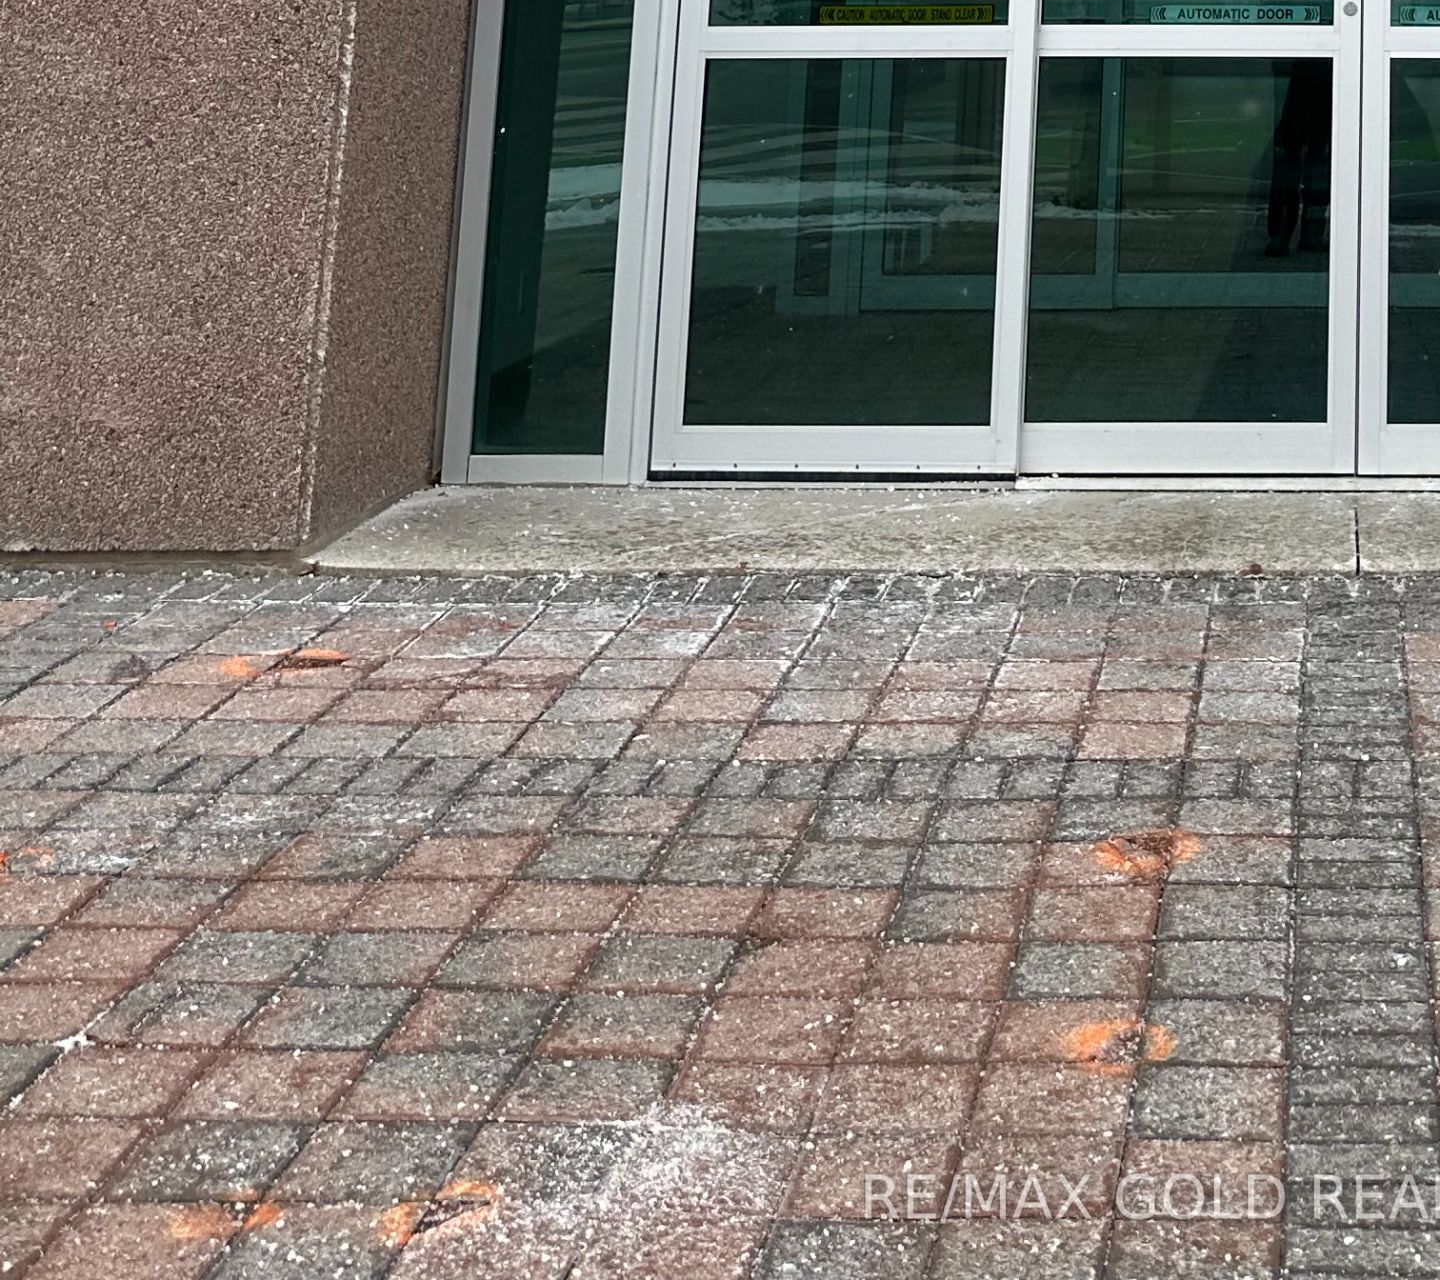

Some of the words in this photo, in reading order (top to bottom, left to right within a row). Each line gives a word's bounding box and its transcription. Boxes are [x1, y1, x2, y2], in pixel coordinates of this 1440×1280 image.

[838, 8, 864, 20] CAUTION
[869, 8, 905, 20] AUTOMATIC
[908, 8, 926, 20] DOOR
[931, 8, 951, 20] STAND
[954, 8, 976, 20] CLEAR
[1177, 8, 1250, 20] AUTOMATIC
[1257, 8, 1294, 20] DOOR
